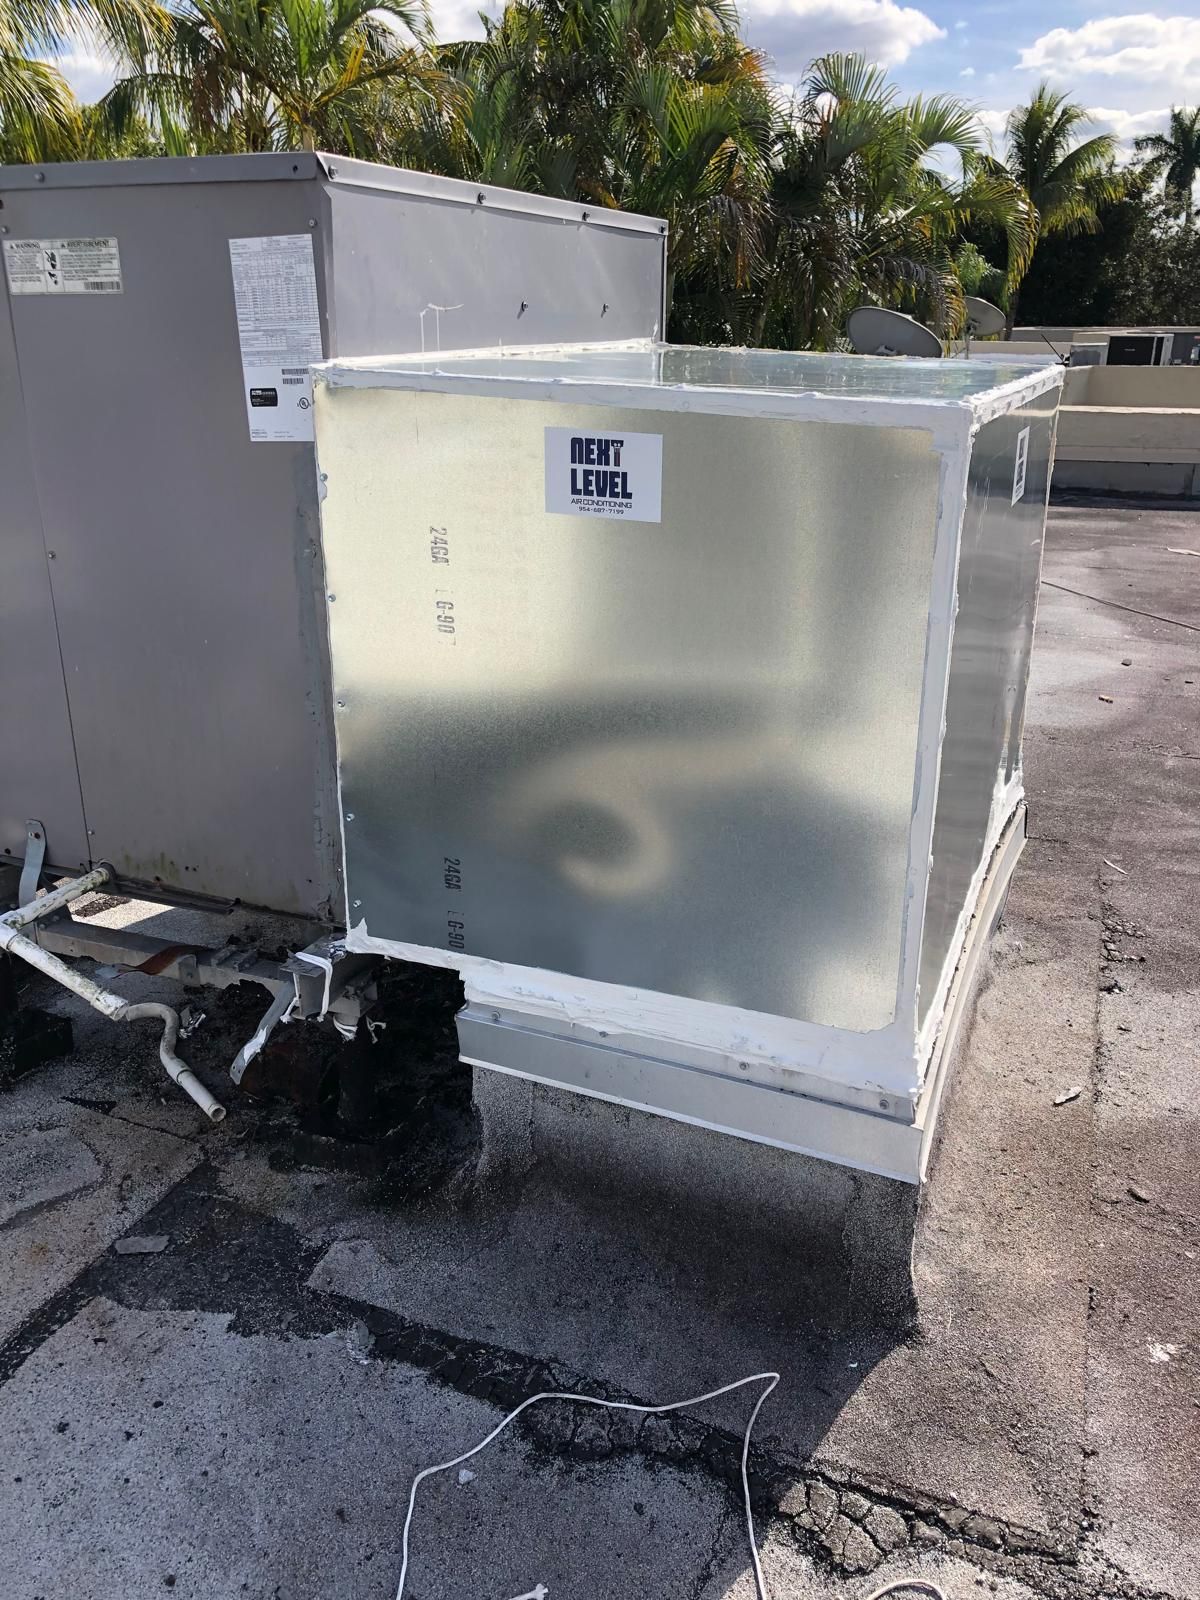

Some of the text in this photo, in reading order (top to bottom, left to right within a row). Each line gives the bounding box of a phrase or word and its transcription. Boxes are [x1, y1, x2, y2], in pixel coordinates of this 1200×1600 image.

[570, 437, 624, 467] NEXT
[570, 468, 633, 500] LEVEL
[578, 506, 625, 515] 954-687-7199
[583, 499, 633, 509] CONDITIONING
[429, 526, 450, 565] 24GA
[444, 857, 462, 891] 24GA
